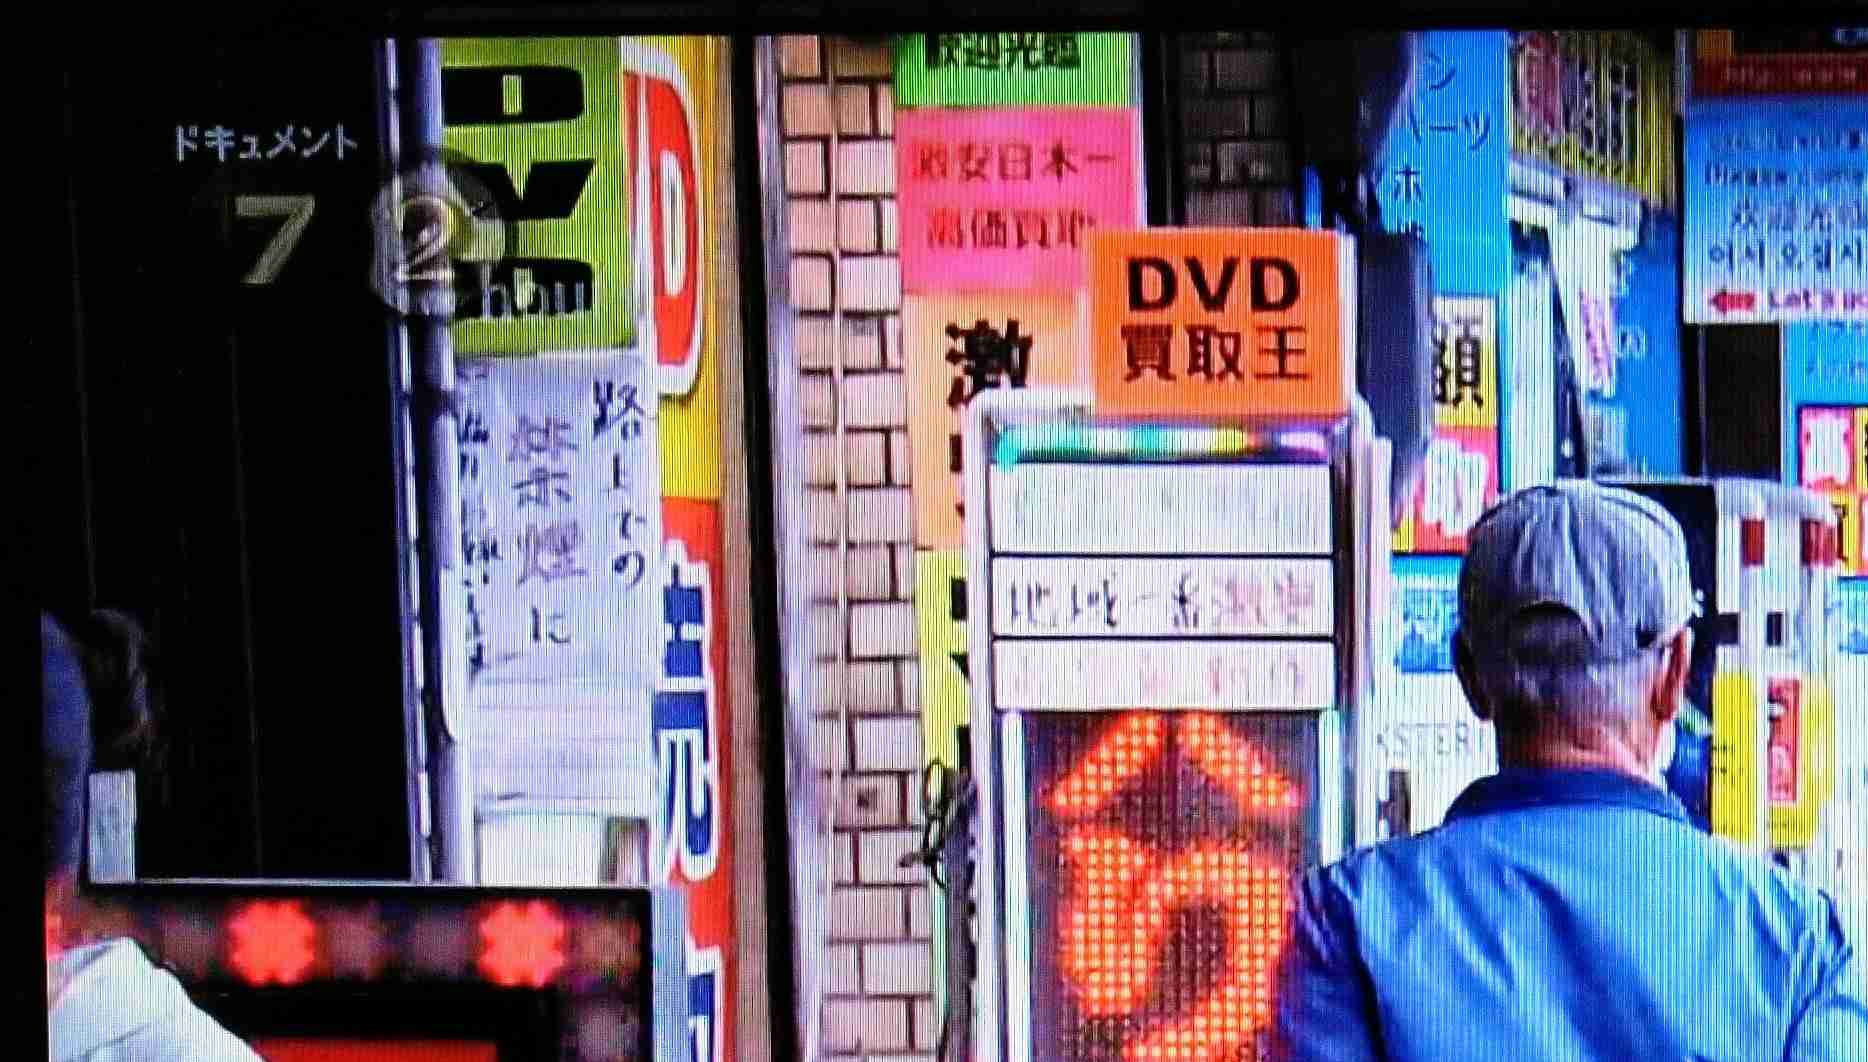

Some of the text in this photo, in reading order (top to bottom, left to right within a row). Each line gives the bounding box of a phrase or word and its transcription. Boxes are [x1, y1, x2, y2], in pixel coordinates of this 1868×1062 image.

[1124, 256, 1300, 314] DVD
[1120, 323, 1309, 385] 買取王
